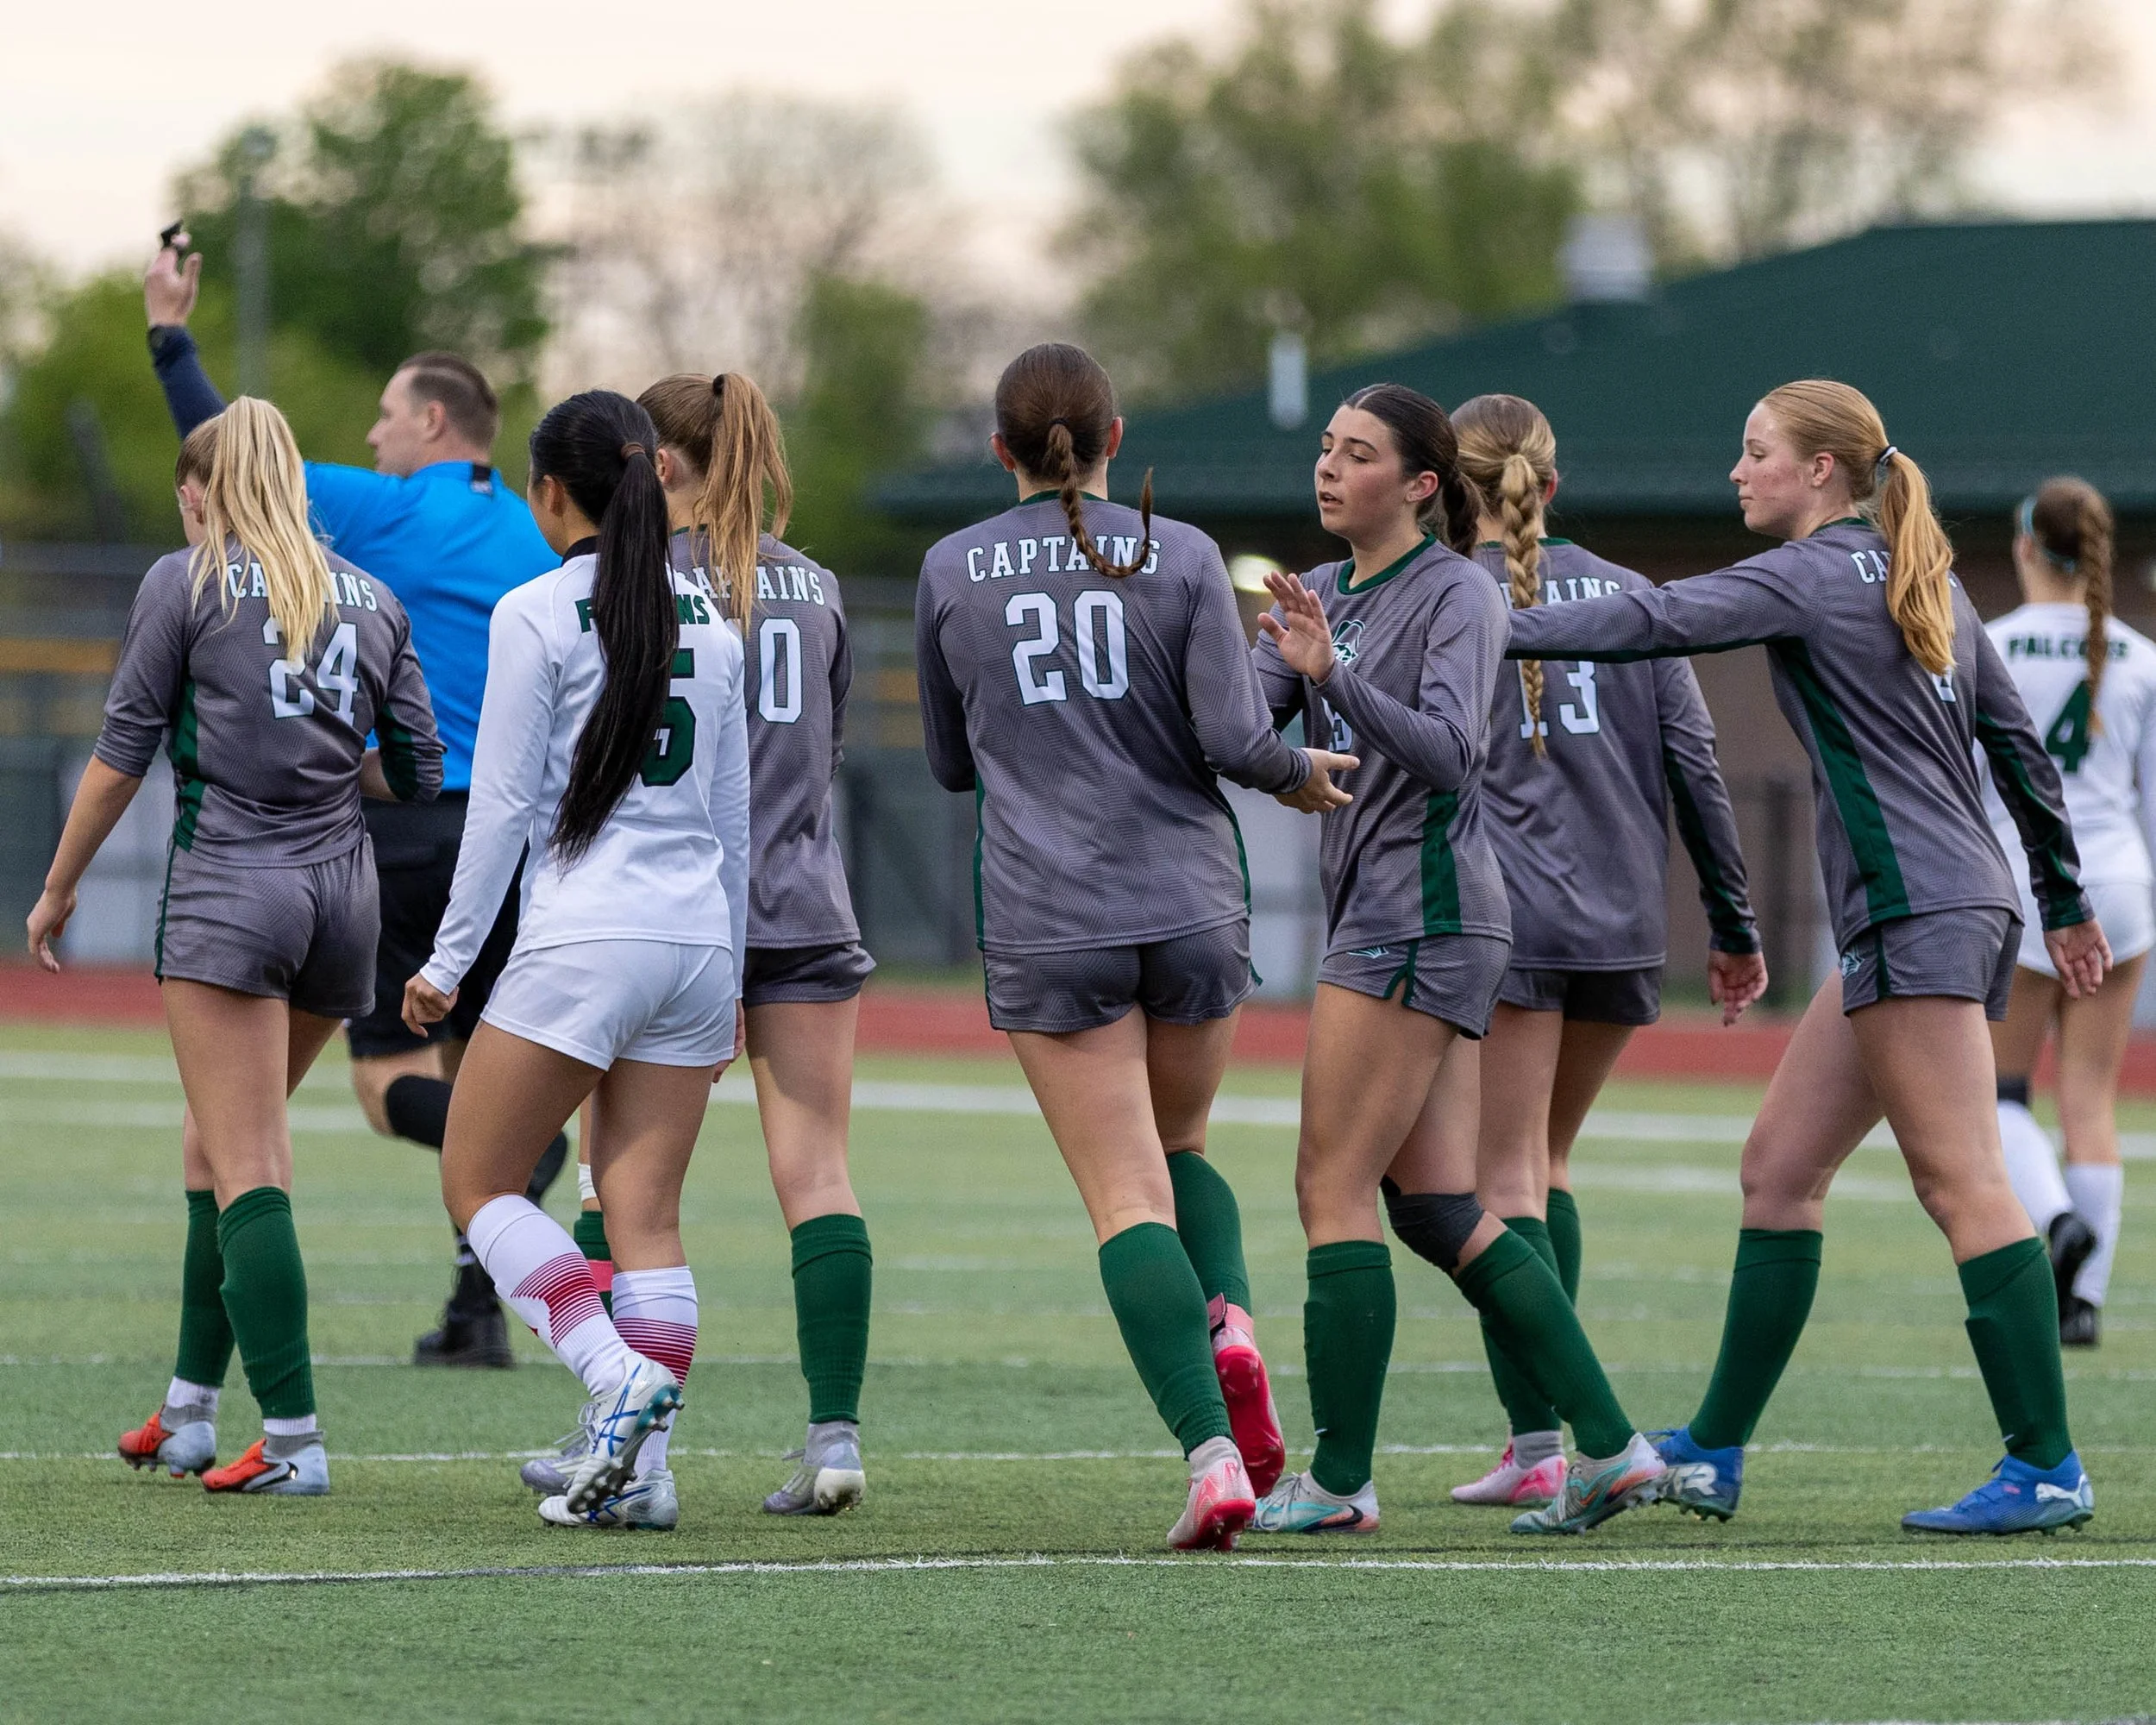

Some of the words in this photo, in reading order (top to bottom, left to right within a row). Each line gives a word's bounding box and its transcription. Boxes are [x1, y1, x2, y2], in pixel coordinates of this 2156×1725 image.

[226, 562, 378, 612] CAINS
[674, 565, 825, 606] AAINS
[966, 535, 1161, 583] CAPTAINS
[262, 618, 360, 727] 24
[724, 618, 803, 724] 0
[1005, 590, 1130, 706] 20
[2045, 678, 2091, 773] 4
